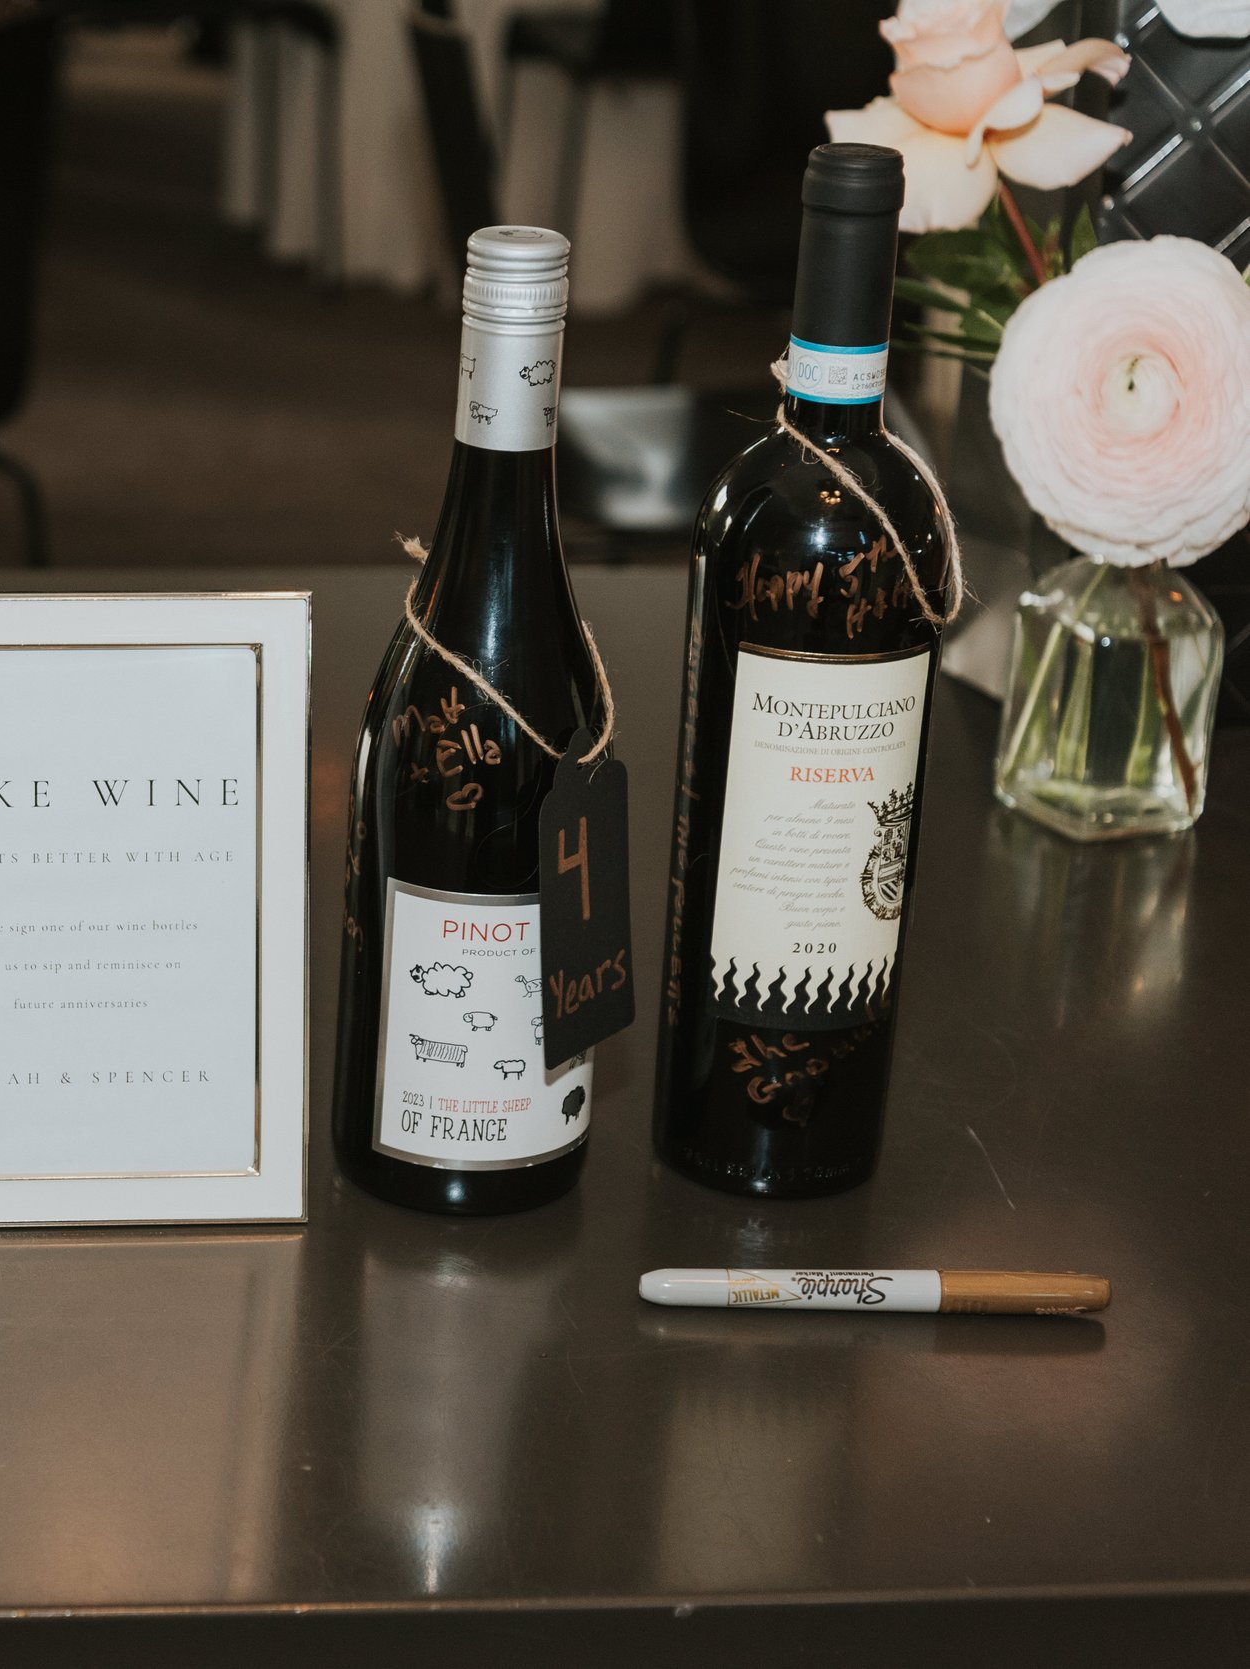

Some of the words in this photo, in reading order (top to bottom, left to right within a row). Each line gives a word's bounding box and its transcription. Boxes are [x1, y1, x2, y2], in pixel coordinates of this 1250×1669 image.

[798, 362, 819, 381] DOC
[752, 691, 916, 721] MONTEPULCIANO
[435, 721, 503, 778] Ella
[754, 739, 818, 755] DENOMINAZIONE
[820, 748, 830, 756] DI
[831, 747, 861, 756] ORIGINE
[790, 765, 875, 783] RISERVA
[92, 777, 240, 807] WINE
[31, 851, 112, 864] BETTER
[125, 851, 181, 863] WITH
[194, 850, 234, 863] AGE
[557, 815, 591, 921] 4
[9, 921, 36, 936] sign
[41, 924, 65, 933] one
[69, 920, 85, 933] of
[88, 922, 110, 932] our
[116, 921, 147, 932] wine
[152, 920, 198, 932] bottles
[442, 919, 532, 943] PINOT
[462, 947, 518, 958] PRODUCT
[521, 947, 537, 956] OF
[792, 942, 837, 954] 2020
[4, 963, 19, 971] us
[24, 962, 37, 971] to
[42, 961, 62, 974] sip
[67, 959, 91, 971] and
[96, 959, 160, 970] reminisce
[550, 948, 628, 1019] Years
[13, 999, 55, 1009] future
[60, 997, 149, 1009] anniversaries
[60, 1072, 72, 1084] &
[92, 1069, 211, 1083] SPENCER
[402, 1091, 425, 1107] 2023
[438, 1097, 460, 1113] THE
[462, 1098, 499, 1114] LITTLE
[501, 1097, 533, 1113] SHEEP
[401, 1109, 423, 1135] OF
[430, 1115, 508, 1142] FRANCE
[732, 1288, 780, 1304] METALLIC
[797, 1275, 894, 1305] Sharpie
